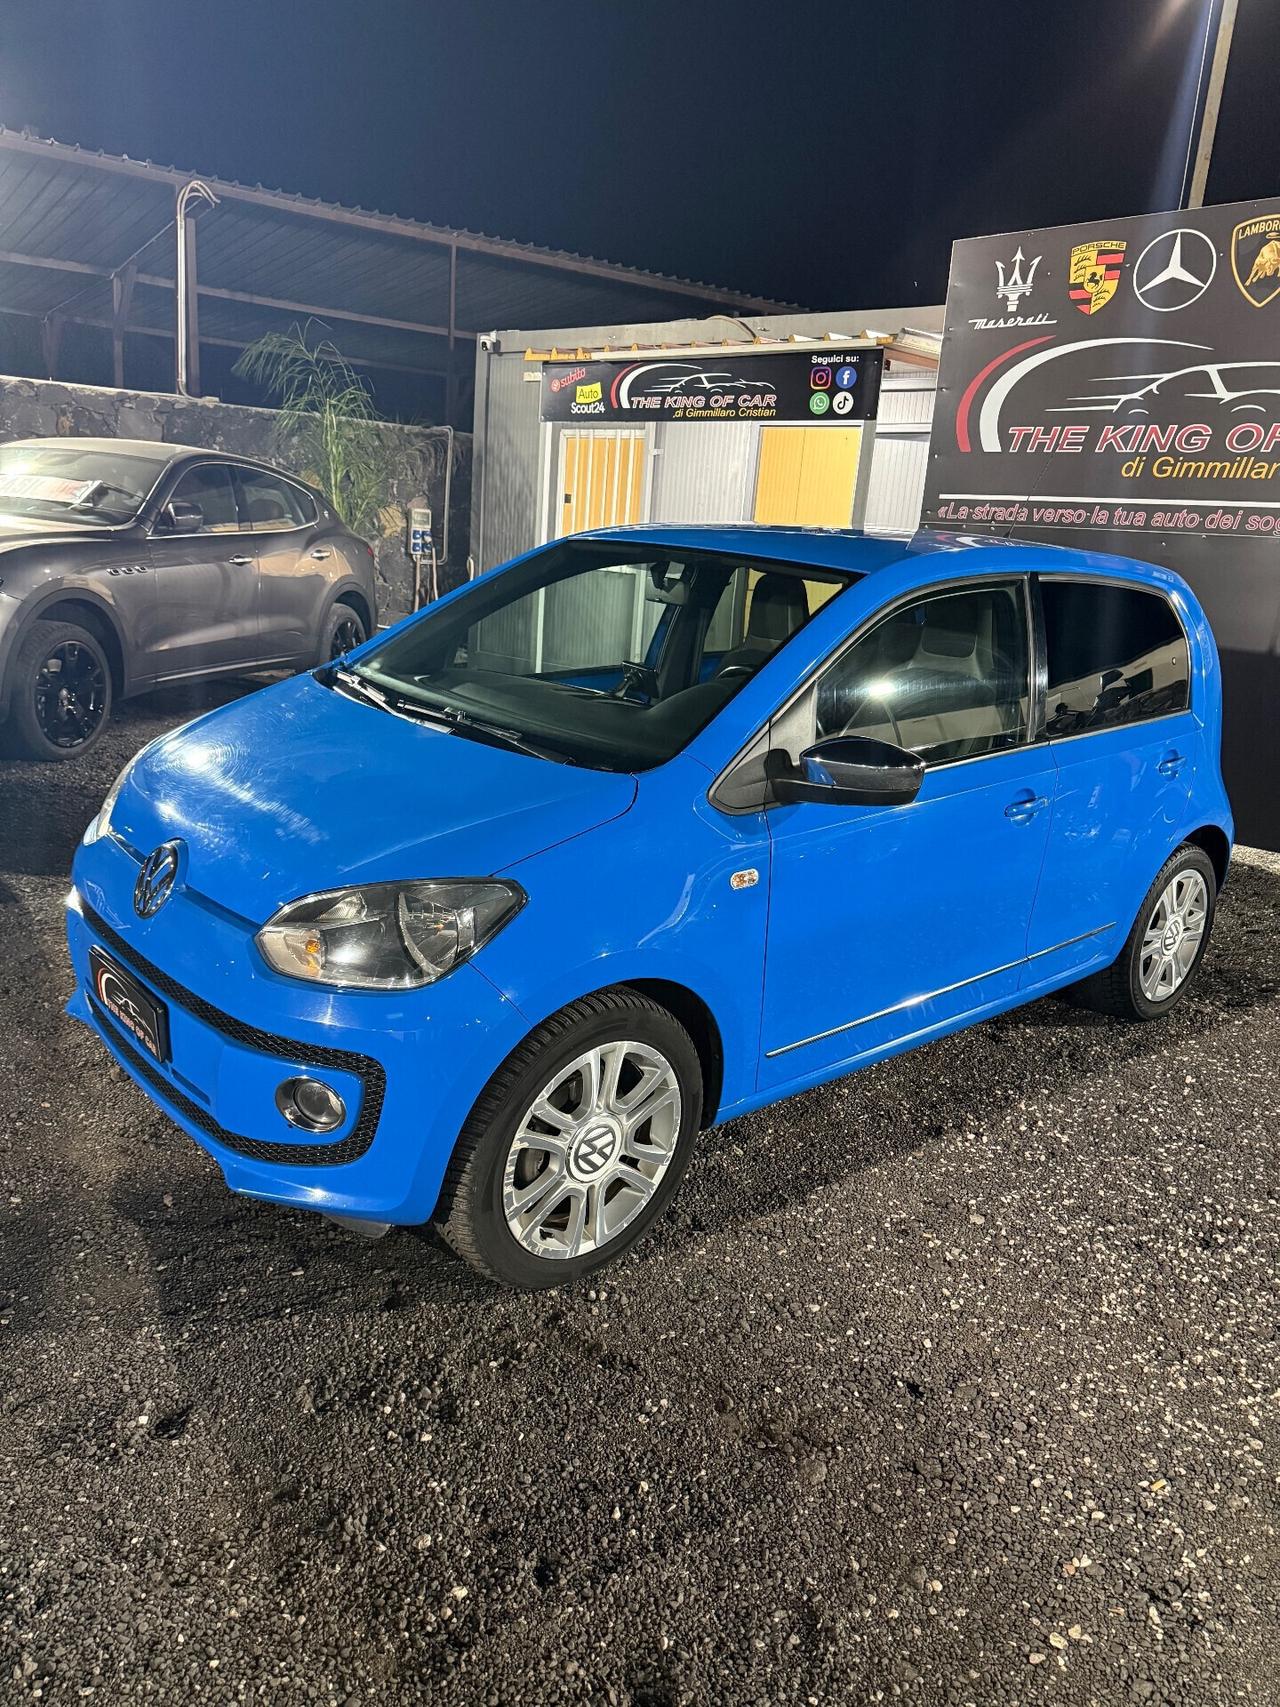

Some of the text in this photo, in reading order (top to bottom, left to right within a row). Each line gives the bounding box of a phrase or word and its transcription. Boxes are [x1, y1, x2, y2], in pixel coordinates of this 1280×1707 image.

[1238, 219, 1280, 240] LAMBOR
[1072, 241, 1126, 255] PORSCHE
[811, 354, 844, 365] Seguici
[560, 367, 586, 388] subito
[578, 388, 599, 399] Auto
[570, 401, 606, 414] Scout24
[631, 394, 777, 409] THE KING OF CAR
[685, 408, 736, 418] Gimmillaro
[738, 407, 776, 417] Cristian
[1008, 425, 1090, 453] THE
[1095, 423, 1212, 453] KING
[1121, 456, 1280, 480] di Gimmillar
[972, 503, 1028, 521] strada
[1033, 508, 1086, 524] verso
[1090, 505, 1109, 525] la
[1113, 506, 1147, 527] tua
[1151, 508, 1200, 529] auto
[1204, 509, 1244, 531] dei
